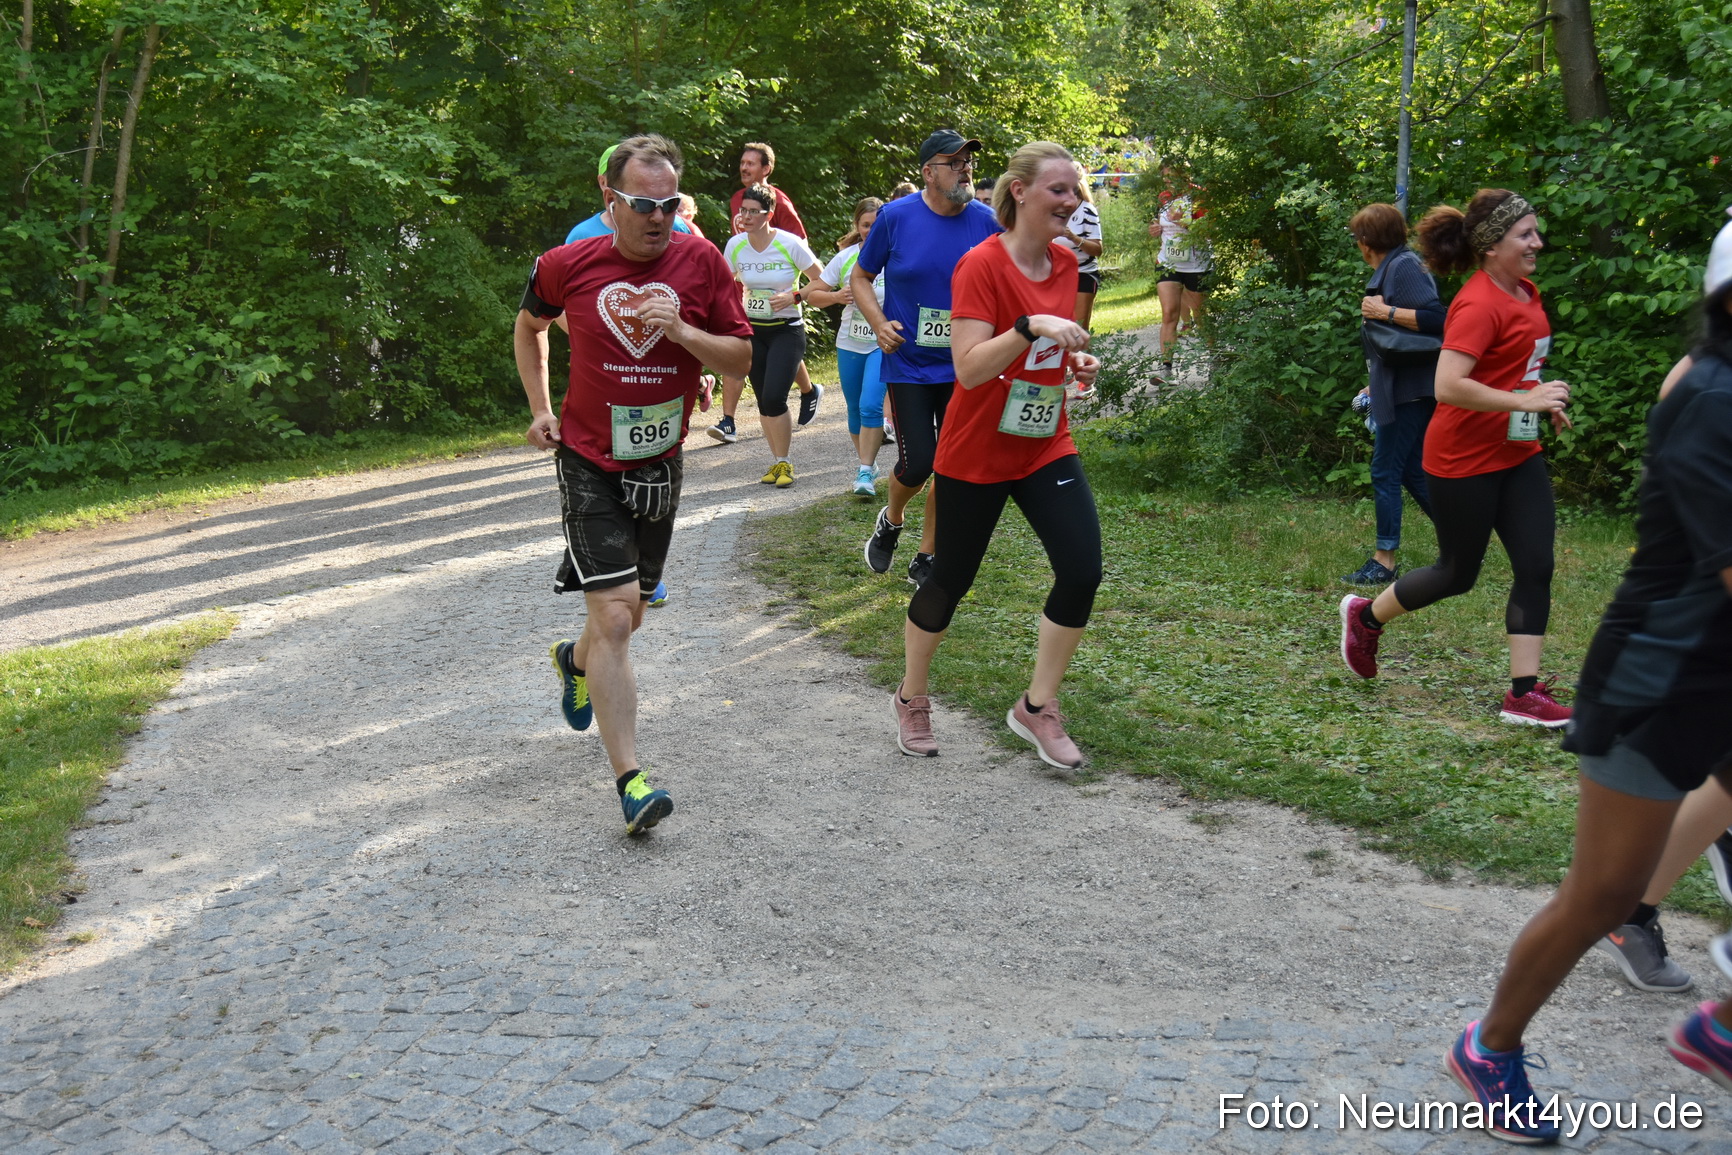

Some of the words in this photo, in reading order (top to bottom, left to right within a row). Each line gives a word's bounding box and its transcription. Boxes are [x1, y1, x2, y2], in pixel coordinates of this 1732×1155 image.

[1168, 247, 1185, 256] 1901
[748, 299, 764, 309] 922
[618, 307, 645, 319] Jür
[853, 324, 874, 336] 9104
[923, 322, 951, 337] 203
[603, 363, 678, 375] Steuerberatung
[640, 375, 662, 384] Herz
[1020, 403, 1054, 423] 535
[629, 420, 669, 444] 696
